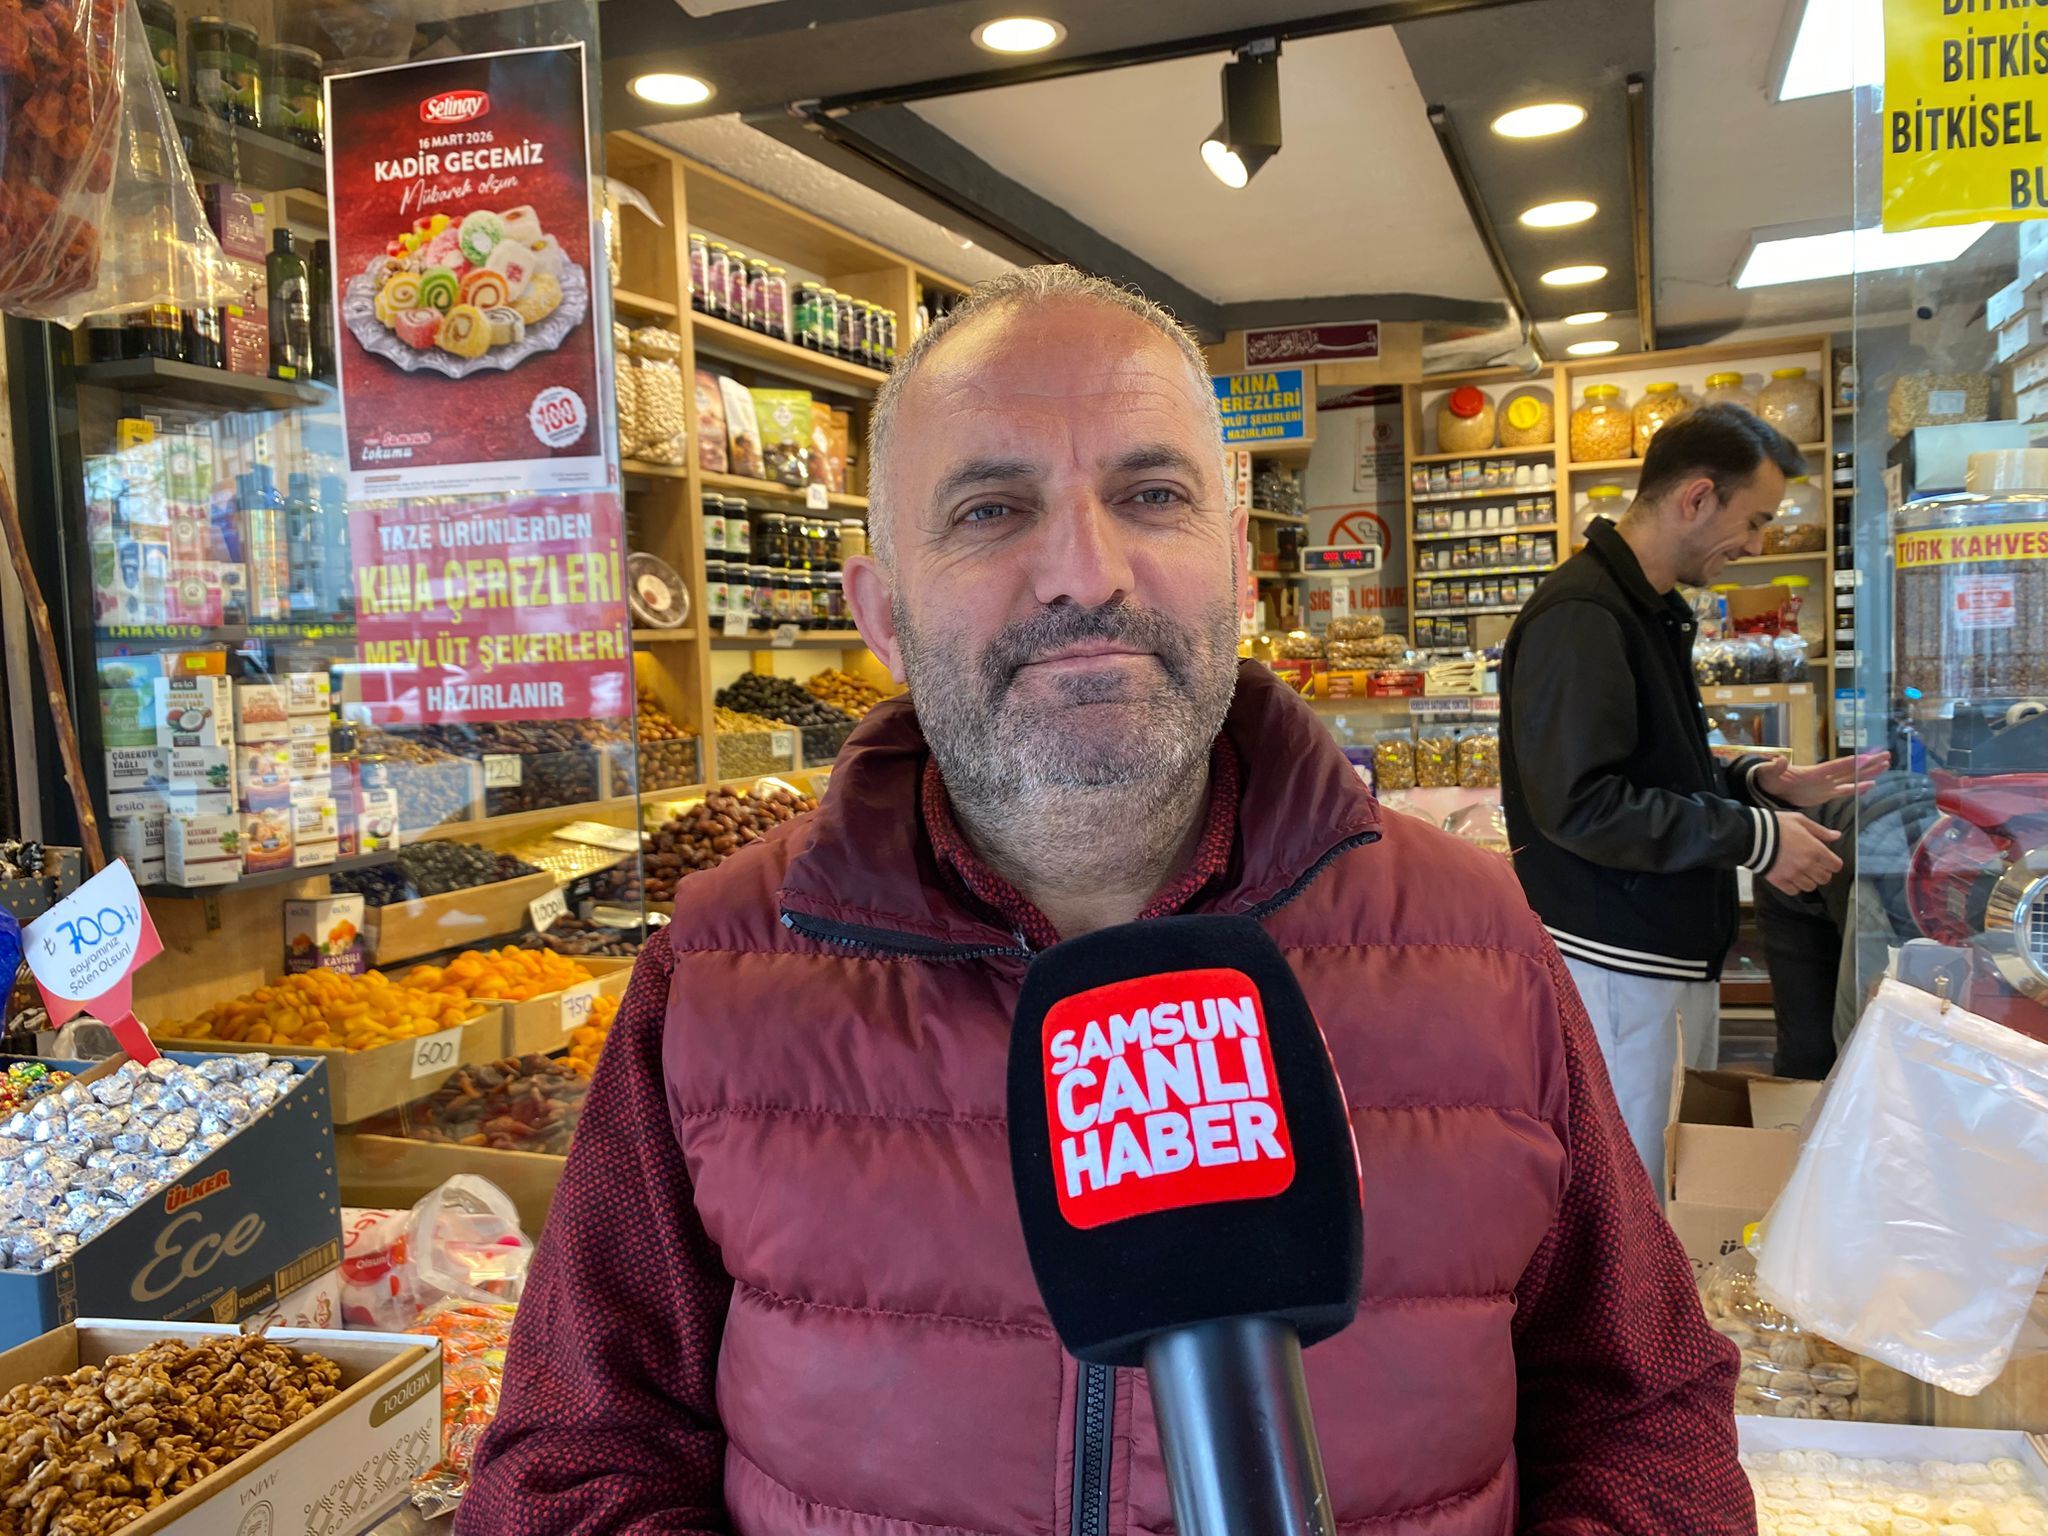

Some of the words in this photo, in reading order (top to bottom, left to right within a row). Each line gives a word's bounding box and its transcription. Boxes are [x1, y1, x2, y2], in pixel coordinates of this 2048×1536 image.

[425, 95, 482, 119] Selinay
[1892, 94, 2041, 154] BİTKİSEL
[419, 138, 429, 149] 16
[431, 133, 464, 147] MART
[466, 131, 494, 144] 2026
[375, 151, 440, 182] KADİR
[444, 139, 544, 173] GECEMİZ
[400, 178, 473, 215] Mübarek
[478, 174, 519, 194] olsun
[1221, 387, 1300, 412] EREZLERİ
[1230, 373, 1279, 395] KINA
[379, 524, 432, 551] TAZE
[439, 513, 592, 547] ÜRÜNLERDEN
[1898, 536, 1943, 563] TÜRK
[359, 562, 434, 615] KINA
[443, 538, 623, 625] ÇEREZLERİ
[1309, 587, 1356, 611] SİGA
[1361, 584, 1407, 611] İÇİLME
[364, 631, 470, 669] MEVLÜT
[479, 622, 625, 673] ŞEKERLERİ
[427, 681, 564, 711] HAZIRLANIR
[116, 801, 144, 812] esila
[564, 994, 592, 1018] 750
[416, 1041, 454, 1068] 600
[1050, 996, 1260, 1075] SAMSUN
[1056, 1037, 1269, 1133] CANLI
[1061, 1101, 1286, 1198] HABER
[166, 1169, 230, 1212] ÜLKER
[131, 1211, 267, 1302] Ece
[383, 1370, 431, 1413] MEDJOOL
[239, 1470, 280, 1506] AMNA
